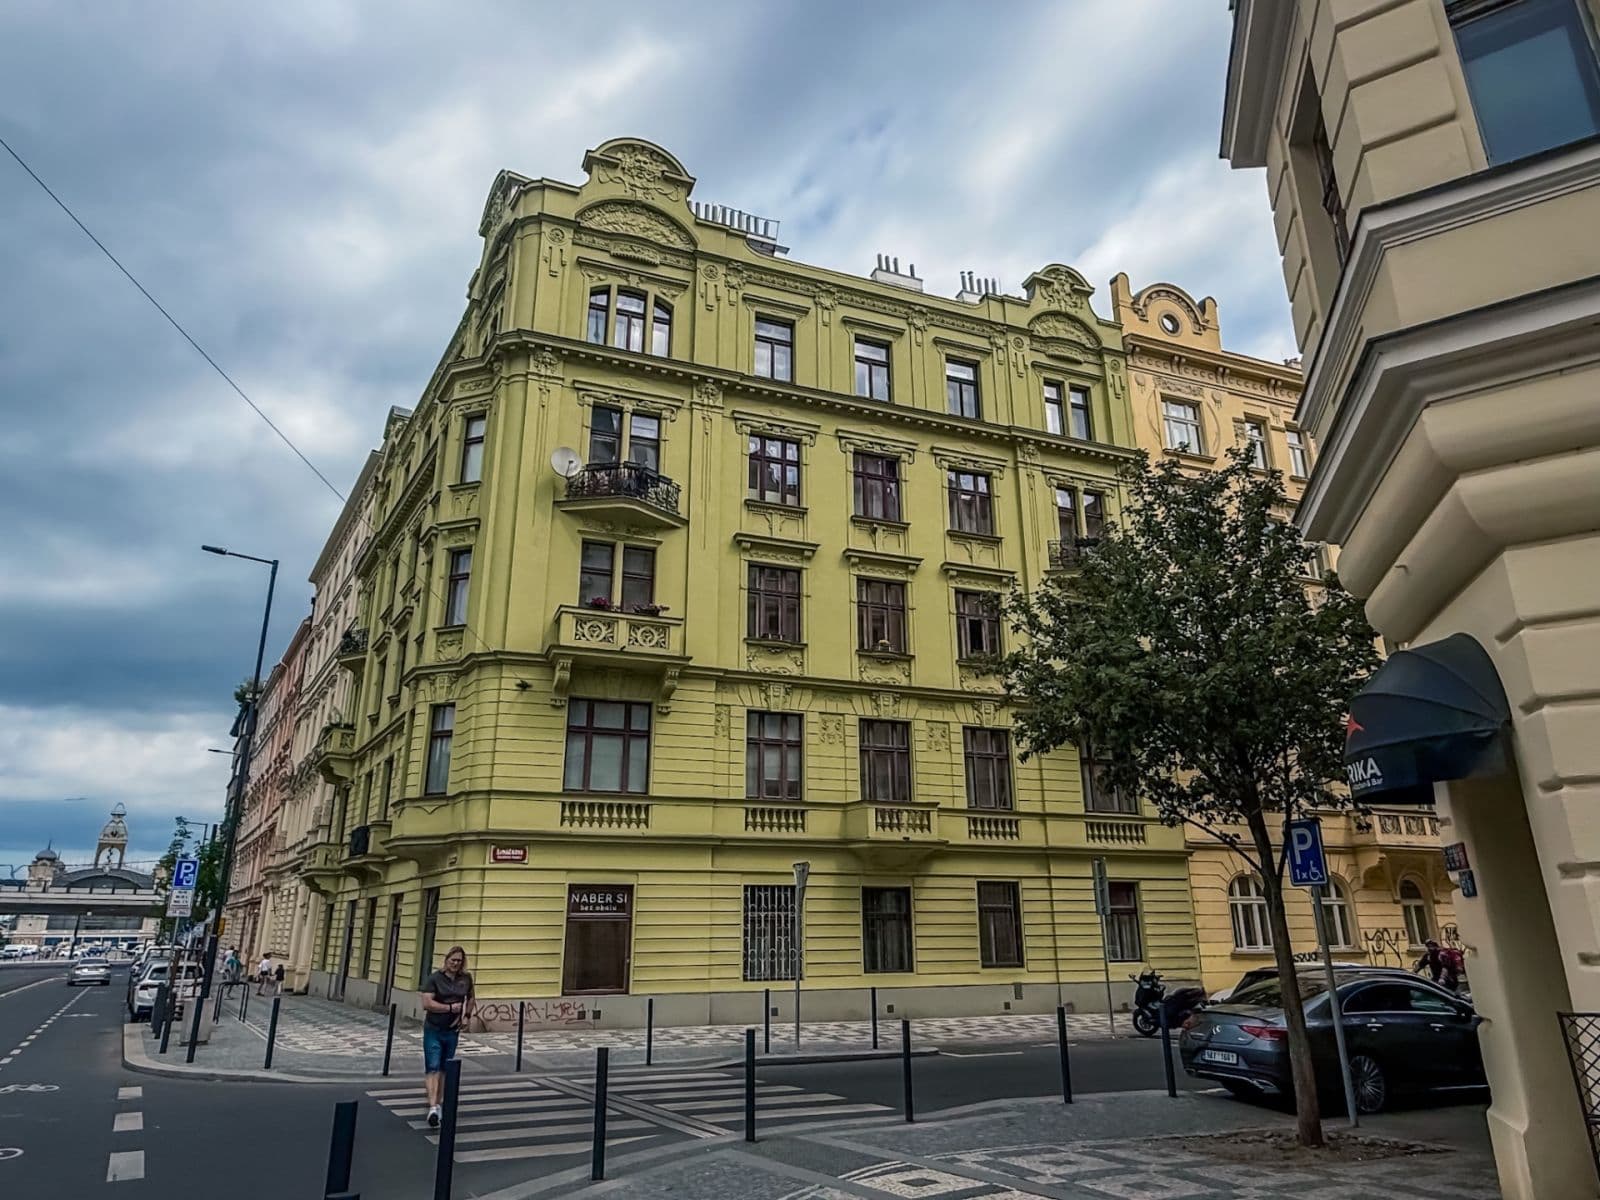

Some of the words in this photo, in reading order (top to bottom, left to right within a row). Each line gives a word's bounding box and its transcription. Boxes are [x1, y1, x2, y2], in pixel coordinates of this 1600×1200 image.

[1291, 827, 1312, 865] P
[180, 862, 195, 879] P
[571, 893, 613, 904] NABER
[615, 893, 628, 904] SI
